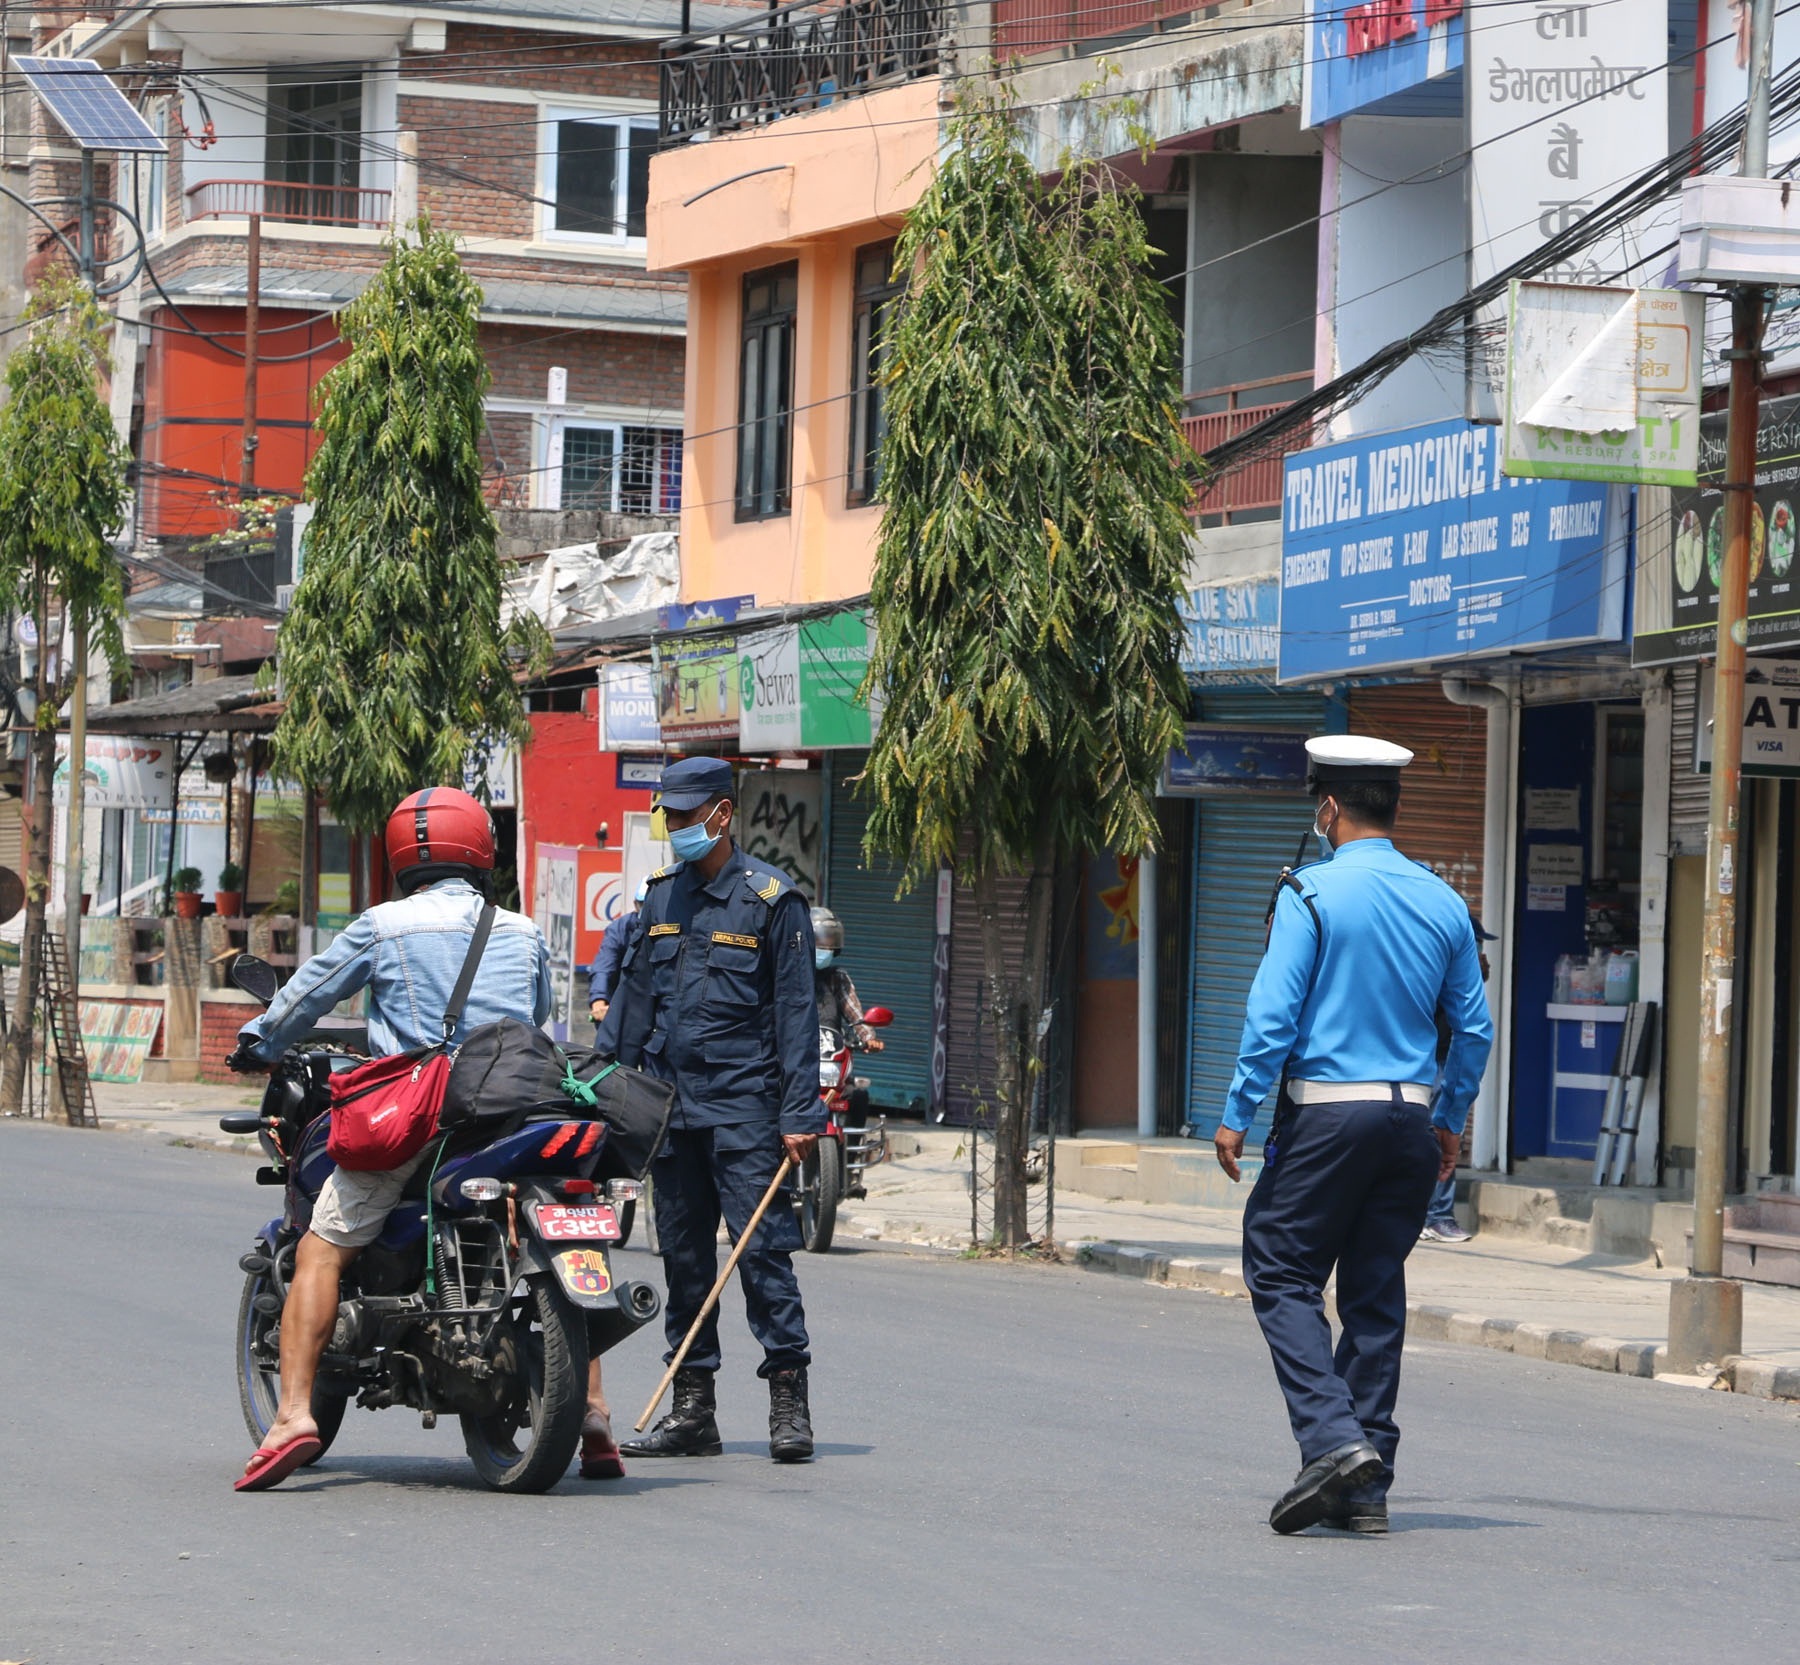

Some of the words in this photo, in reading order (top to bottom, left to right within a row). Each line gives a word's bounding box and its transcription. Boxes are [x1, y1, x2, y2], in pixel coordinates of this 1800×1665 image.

[1565, 445, 1624, 459] RESORT
[1649, 451, 1676, 463] SPA
[1286, 456, 1364, 531] TRAVEL
[1368, 426, 1487, 516] MEDICINCE
[1284, 548, 1331, 587] EMERGENCY
[1340, 543, 1357, 578] OPD
[1358, 536, 1394, 574] SERVICE
[1402, 530, 1429, 566] X-RAY
[1441, 525, 1459, 560] LAB
[1460, 517, 1499, 558] SERVICE
[1511, 512, 1531, 547] ECG
[1548, 501, 1603, 541] PHARMACY
[1226, 583, 1258, 621] SKY
[1409, 575, 1452, 607] DOCTORS
[1757, 741, 1784, 752] VISA
[714, 933, 734, 943] NEPAL
[735, 935, 756, 946] POLICE
